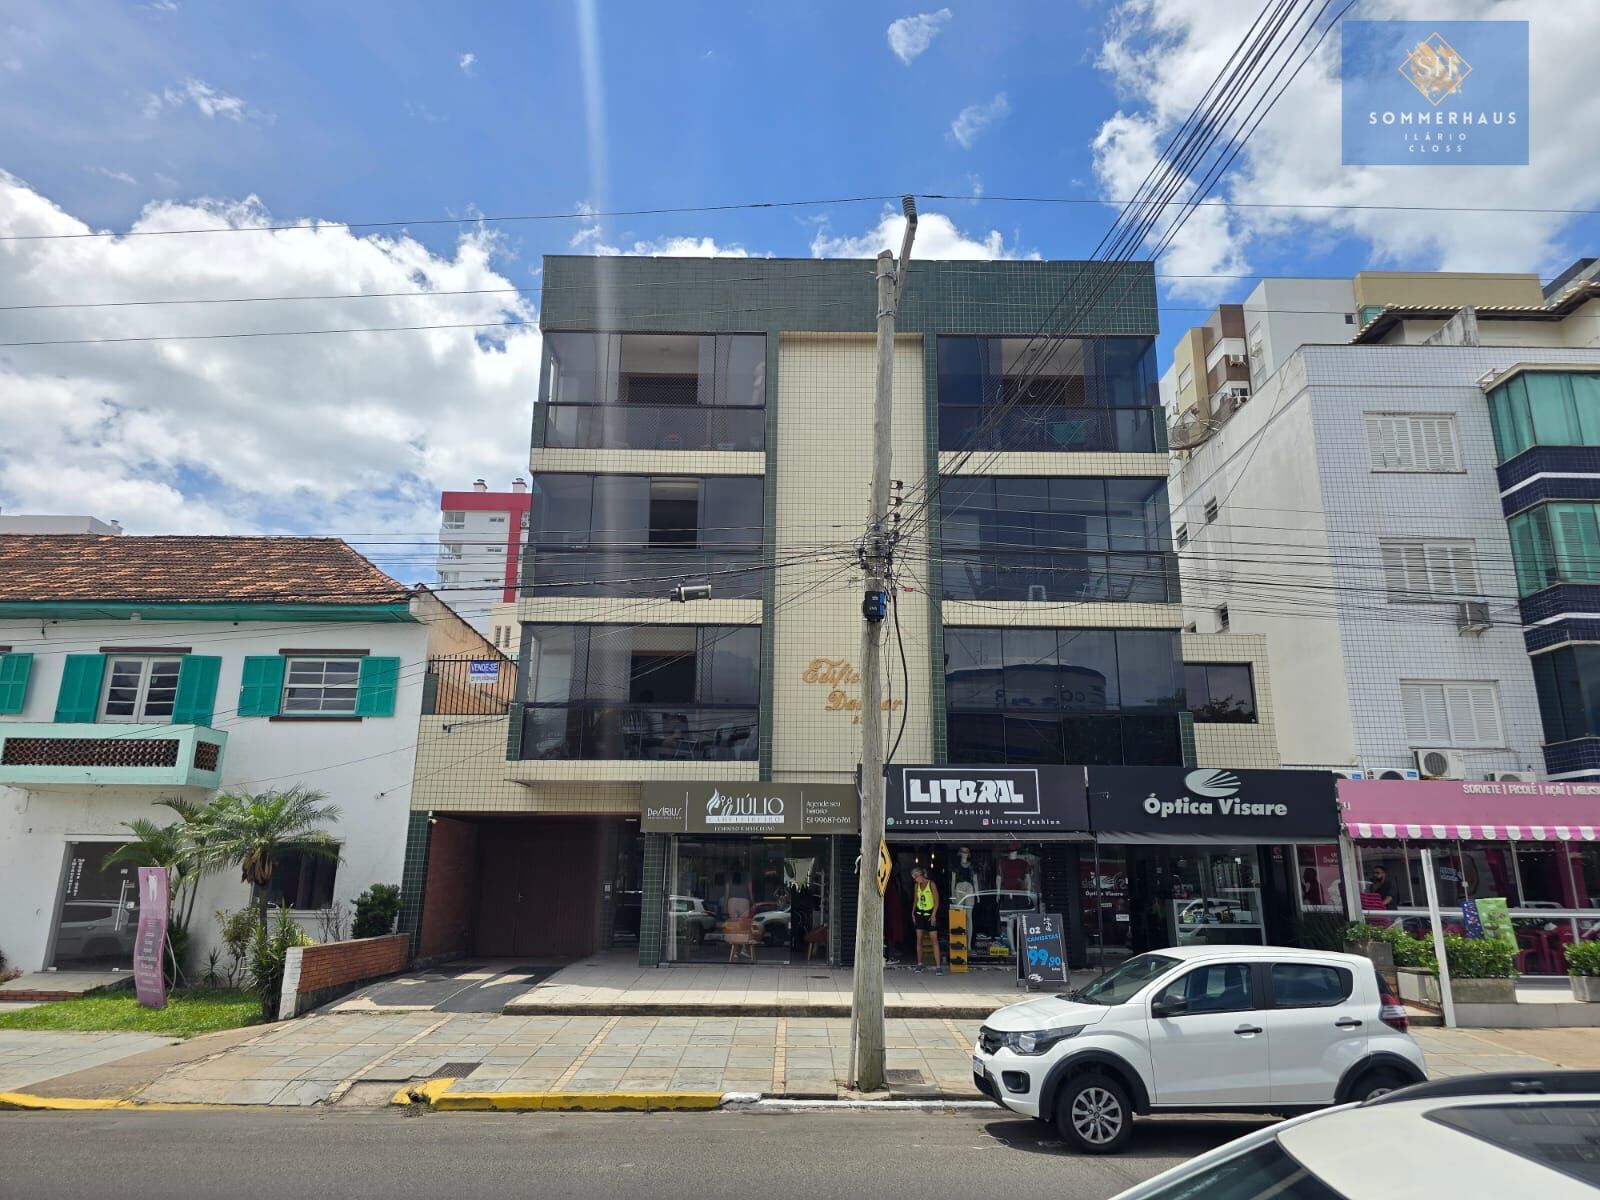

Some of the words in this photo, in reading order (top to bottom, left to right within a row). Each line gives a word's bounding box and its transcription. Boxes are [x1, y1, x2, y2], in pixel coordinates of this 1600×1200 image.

[909, 778, 1024, 804] LITORAL
[1463, 784, 1501, 794] SORVETE
[734, 792, 785, 815] JÚLIO
[1144, 792, 1213, 818] Óptica
[1218, 797, 1288, 816] Visare
[1085, 889, 1104, 897] Óptia
